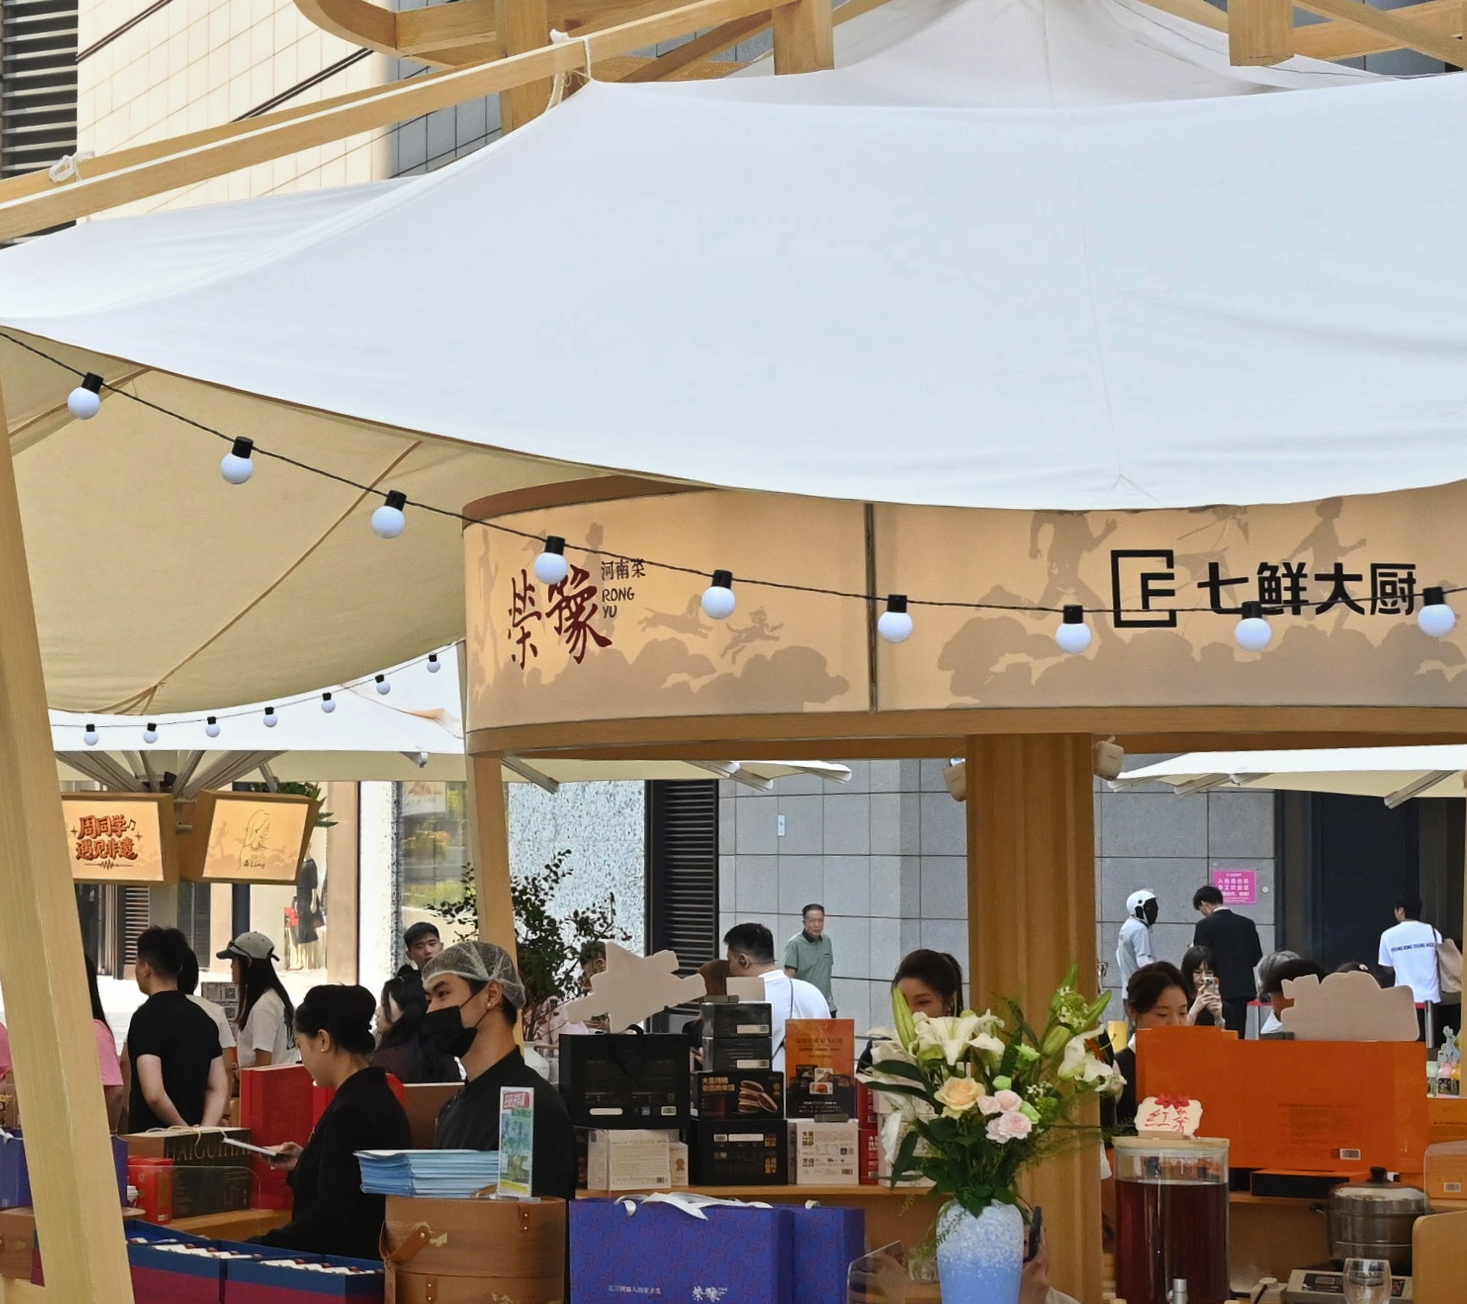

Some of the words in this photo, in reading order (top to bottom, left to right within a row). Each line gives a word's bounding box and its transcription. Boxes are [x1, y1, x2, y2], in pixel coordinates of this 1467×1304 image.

[602, 586, 635, 602] RONG
[1197, 562, 1416, 616] 七鲜大厨
[603, 605, 617, 619] YU
[77, 814, 128, 839] 周同学
[75, 838, 139, 861] 遇见非遗
